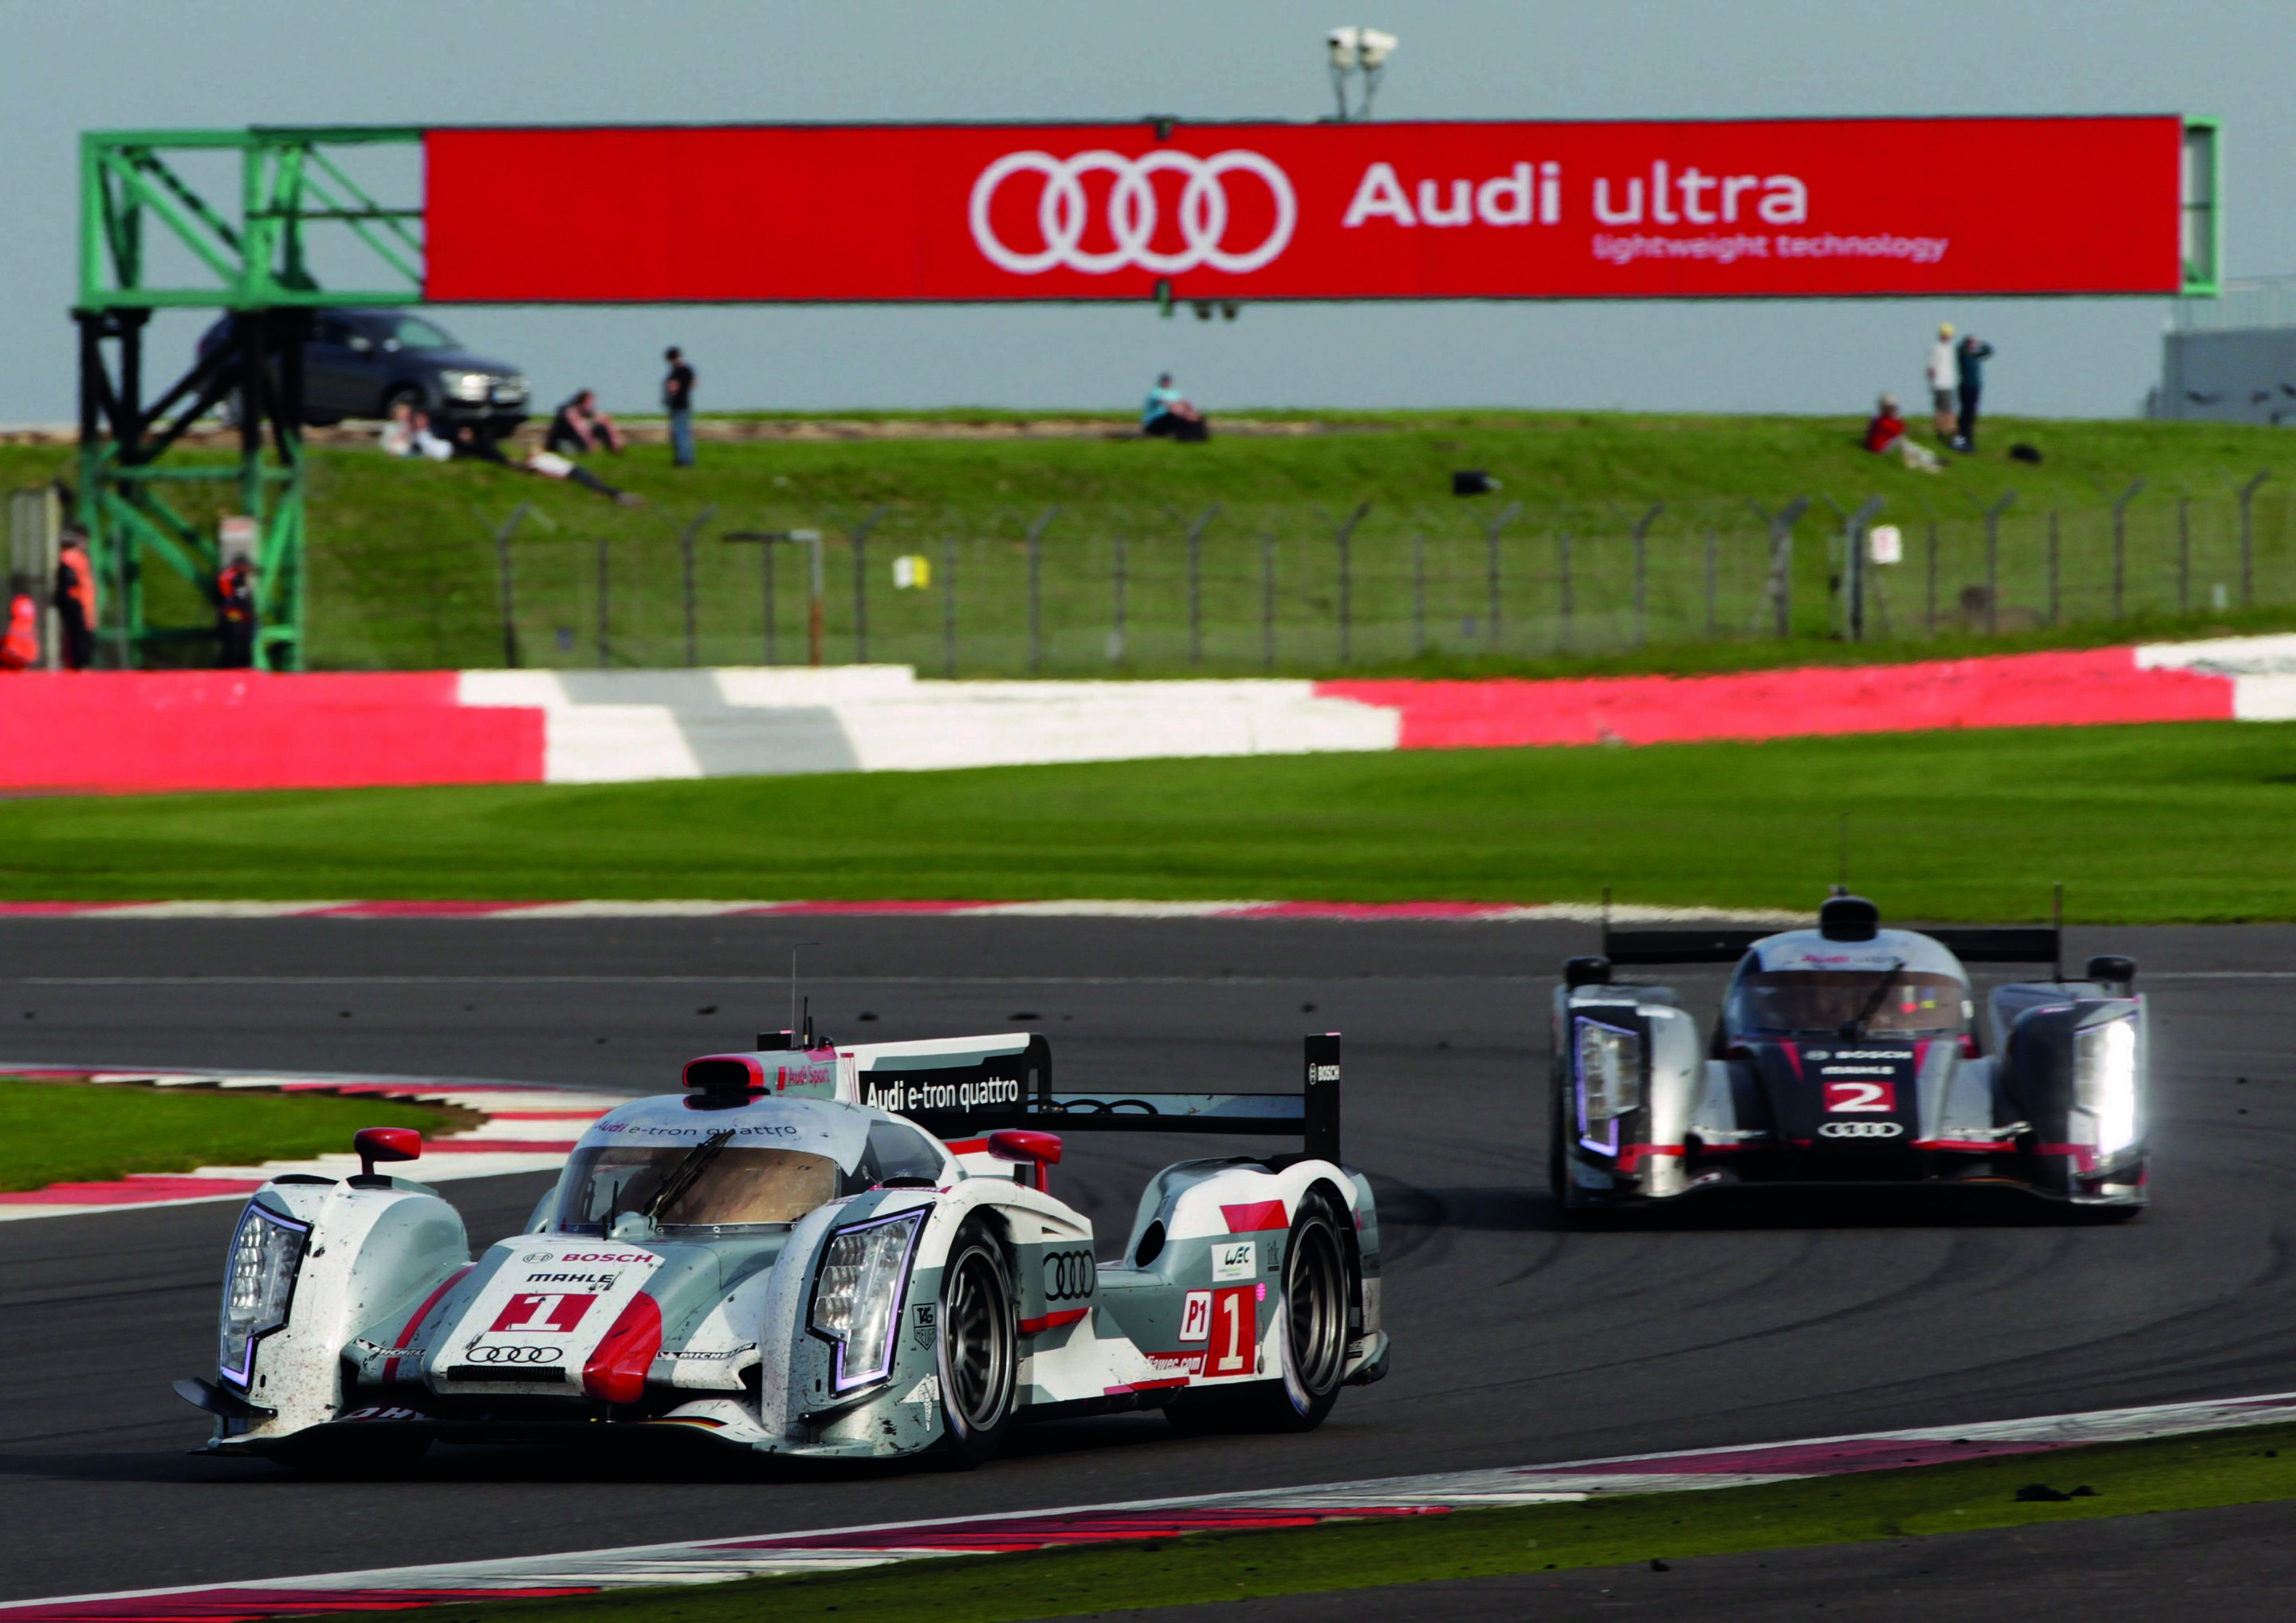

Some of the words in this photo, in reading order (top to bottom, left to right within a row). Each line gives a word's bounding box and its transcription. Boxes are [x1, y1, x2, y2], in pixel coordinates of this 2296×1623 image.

[1341, 159, 1562, 228] Audi
[1593, 159, 1808, 226] ultra
[1593, 233, 1768, 265] lightweight
[1775, 234, 1948, 263] technology
[867, 1081, 905, 1113] Audi
[907, 1082, 957, 1110] e-tron
[959, 1076, 1019, 1114] quattro
[1830, 1082, 1891, 1112] 2
[595, 1119, 629, 1133] Audi
[628, 1125, 697, 1136] e-tron
[706, 1126, 797, 1138] quattro
[561, 1253, 654, 1263] BOSCH
[1225, 1246, 1251, 1266] WEC
[526, 1274, 615, 1283] MAHLE
[504, 1294, 565, 1331] 1
[917, 1307, 934, 1324] TAG
[1185, 1299, 1207, 1334] P1
[1217, 1293, 1244, 1370] 1
